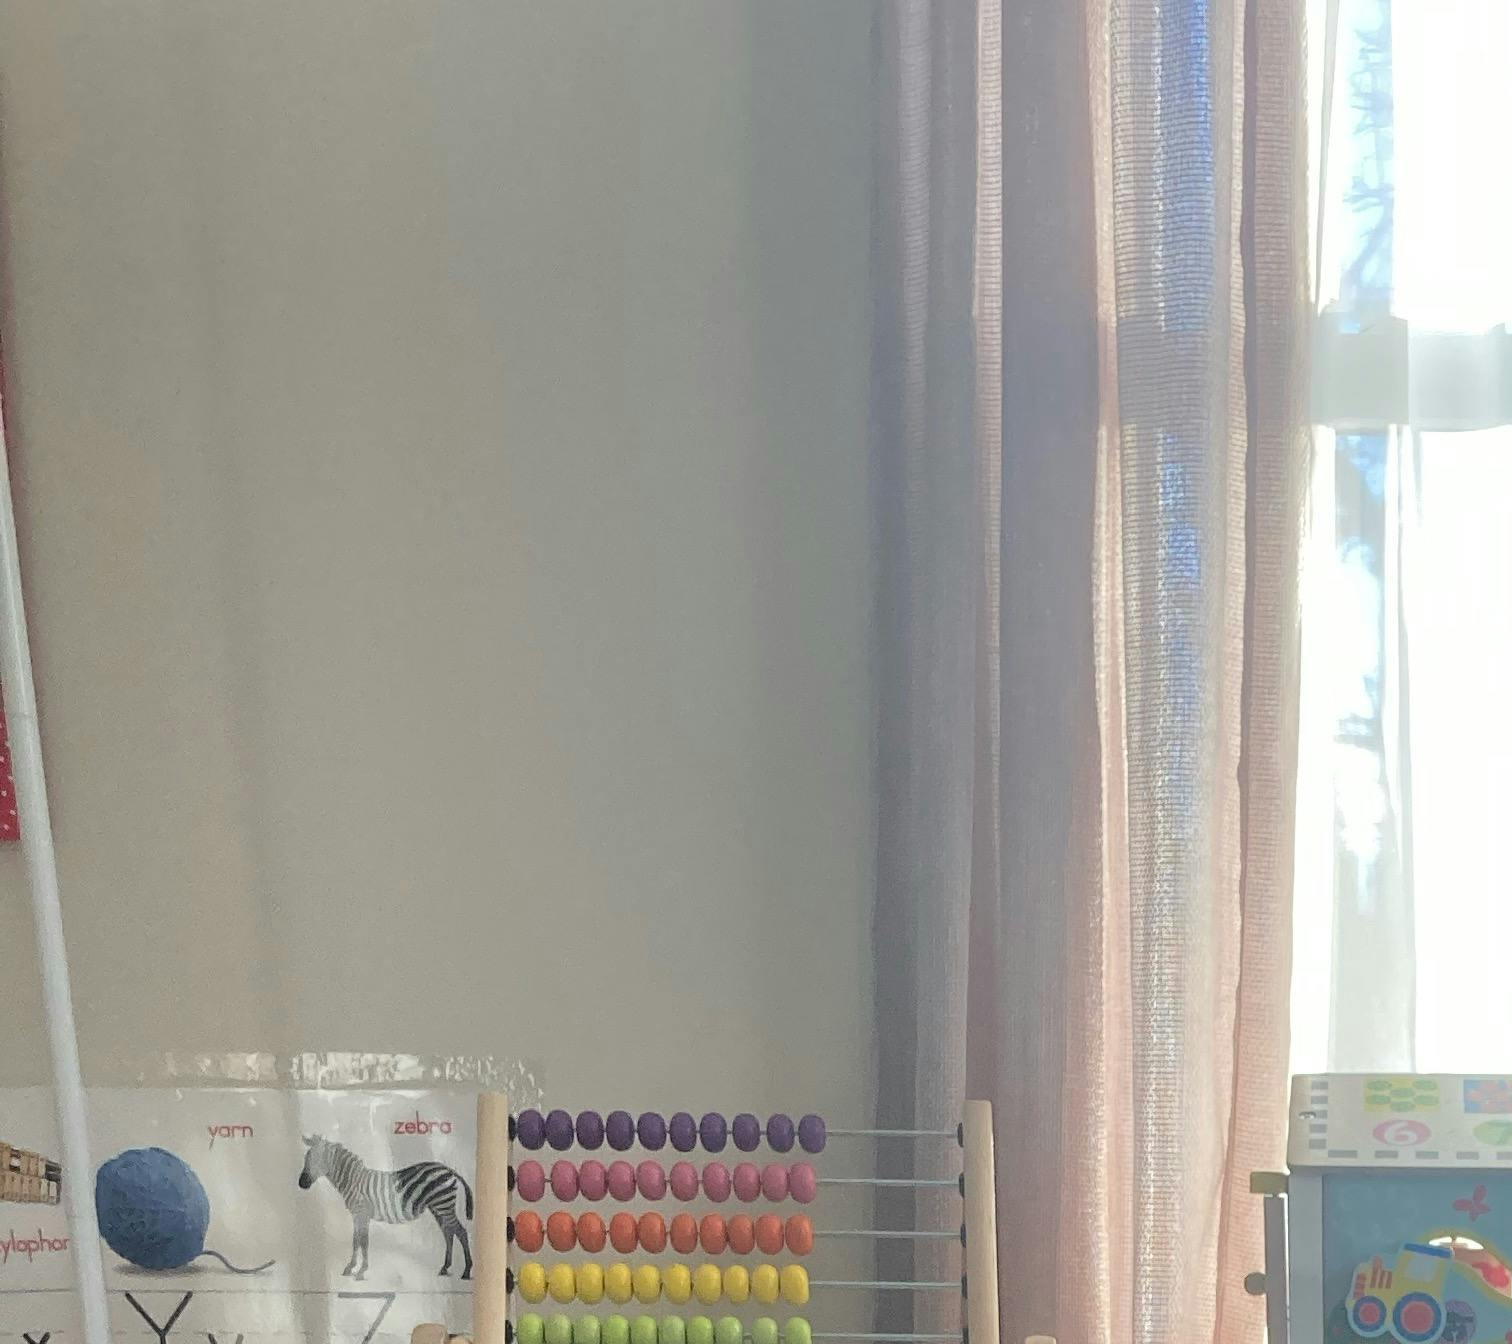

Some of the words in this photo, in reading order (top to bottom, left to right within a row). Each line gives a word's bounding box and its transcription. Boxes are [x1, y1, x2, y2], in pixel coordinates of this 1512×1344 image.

[393, 1109, 452, 1136] zebra
[1383, 1120, 1418, 1146] 6
[207, 1122, 254, 1151] yarn
